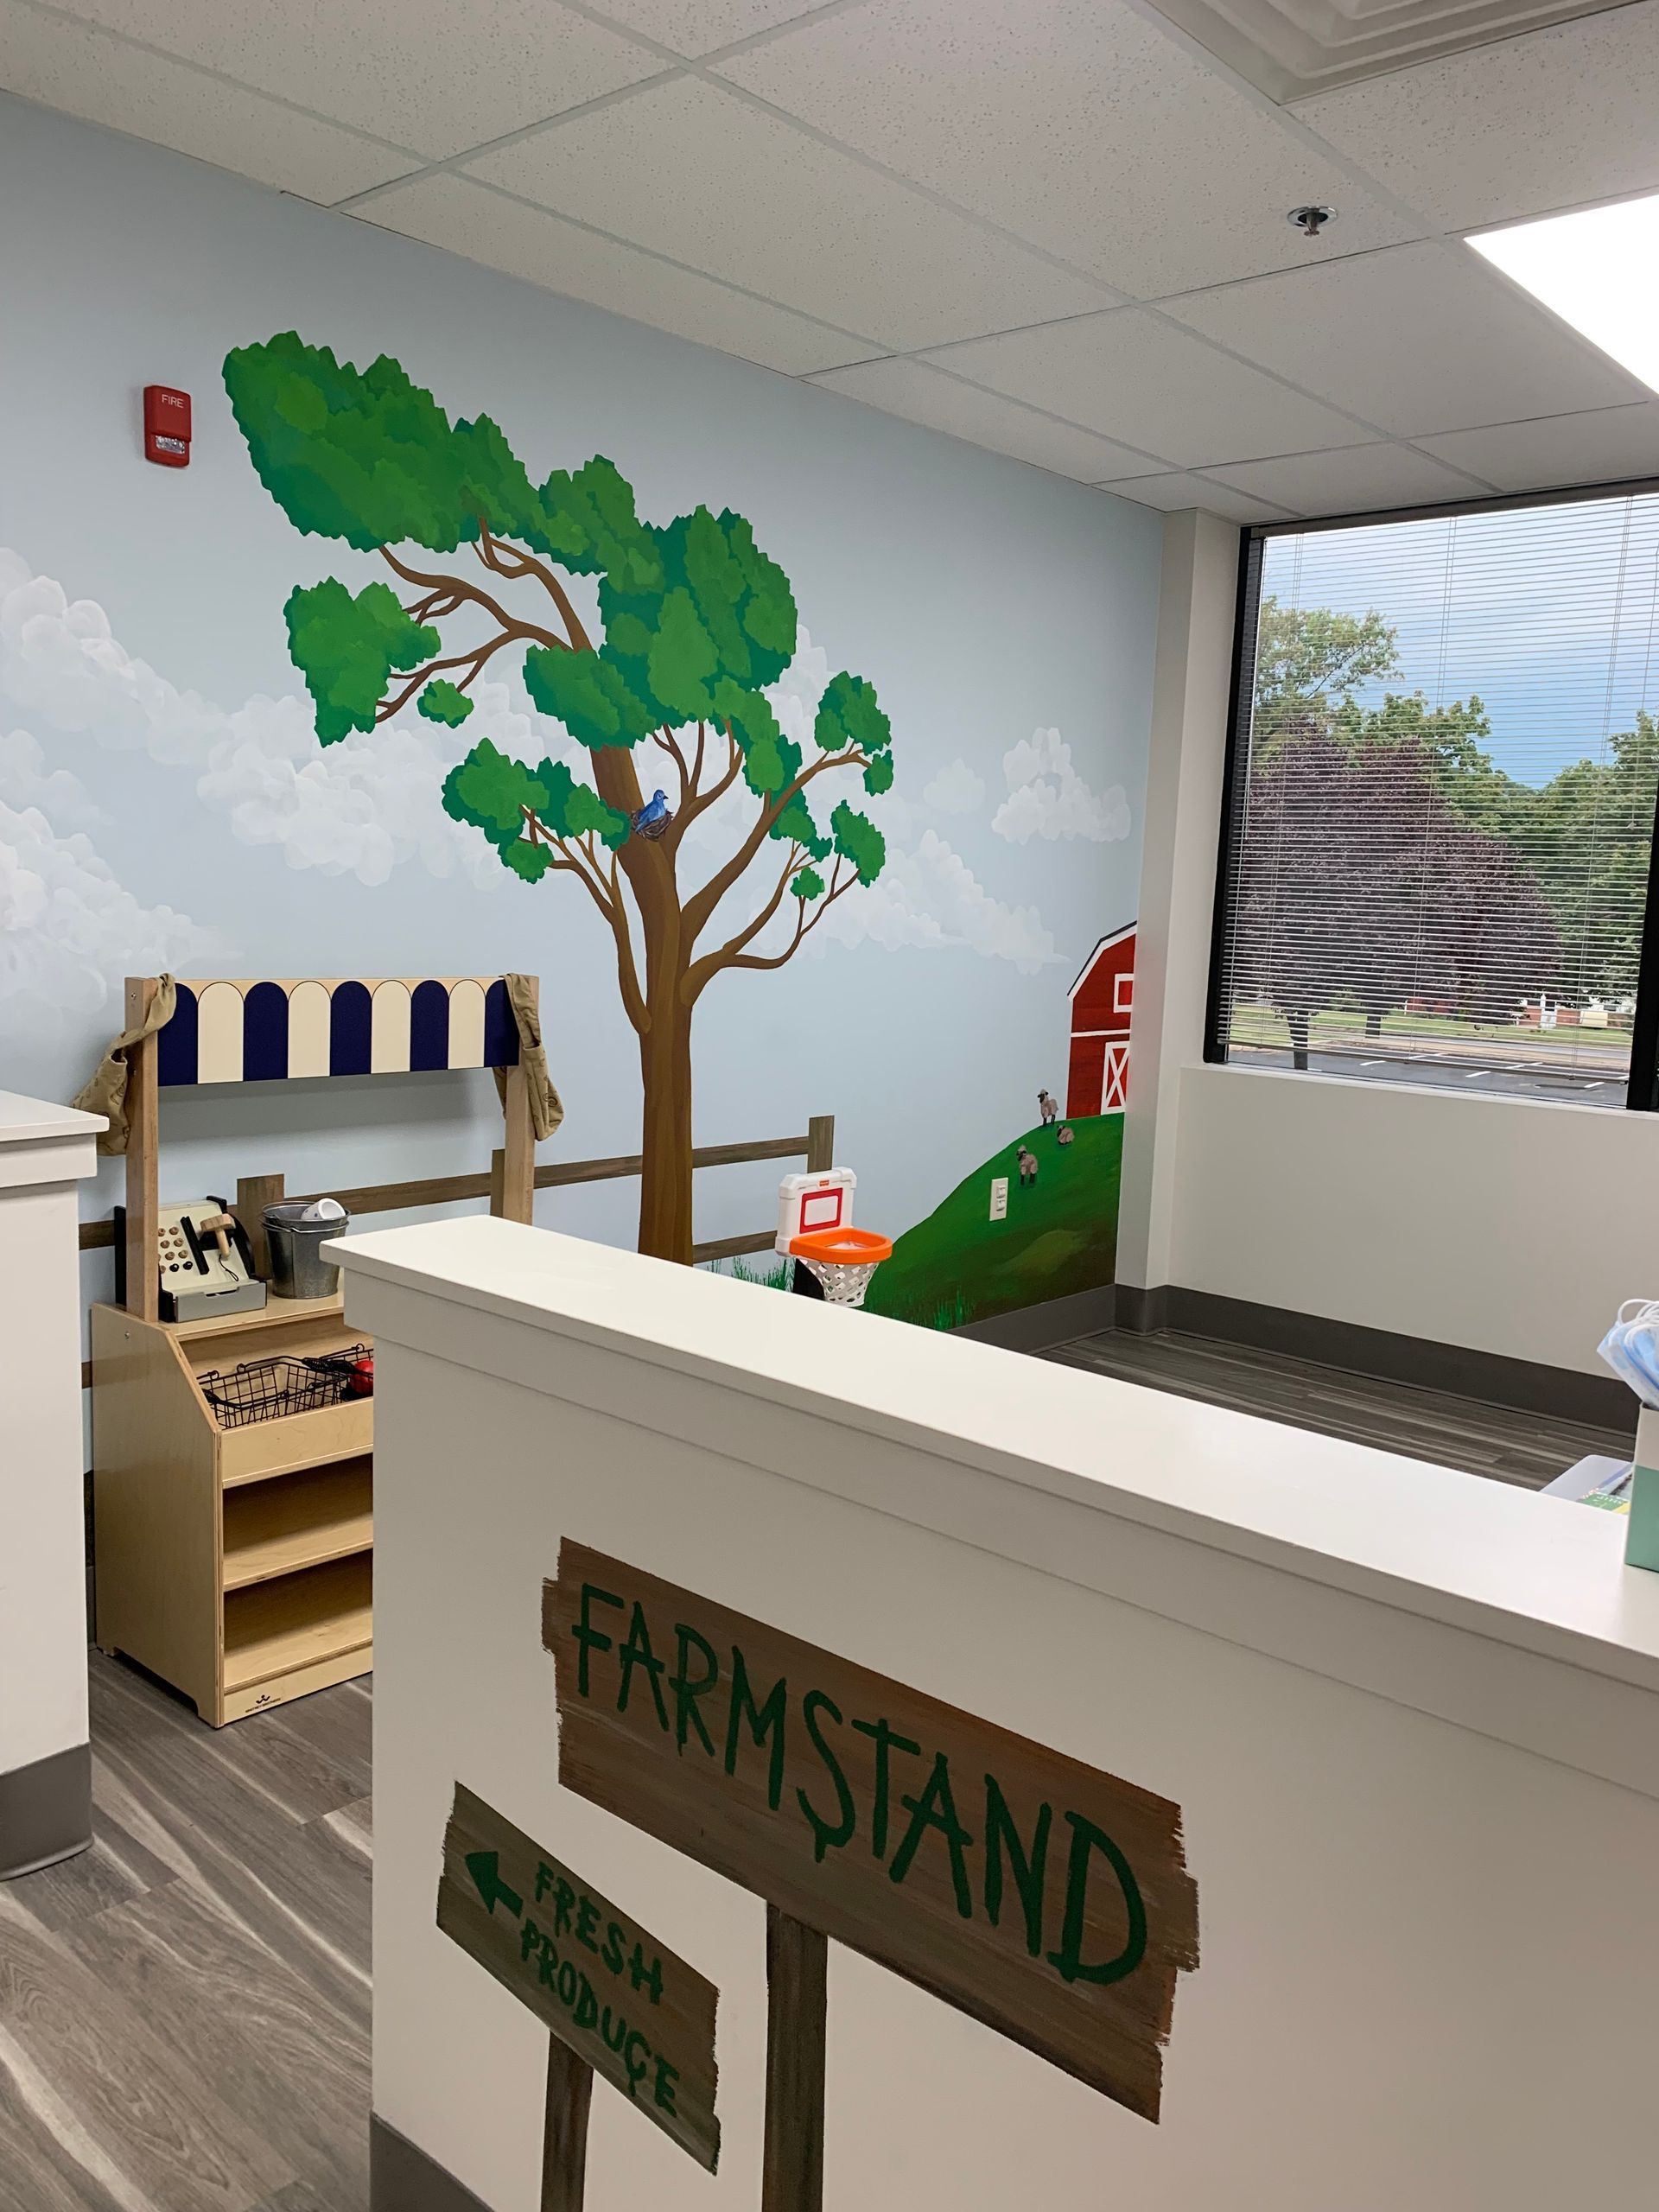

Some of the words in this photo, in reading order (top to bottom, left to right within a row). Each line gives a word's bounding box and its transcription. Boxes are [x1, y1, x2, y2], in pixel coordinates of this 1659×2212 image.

[162, 394, 184, 408] FIRE
[571, 1583, 1147, 1985] FARMSTAND
[520, 1918, 679, 2117] PRODUCE
[534, 1860, 664, 2005] FRESH
